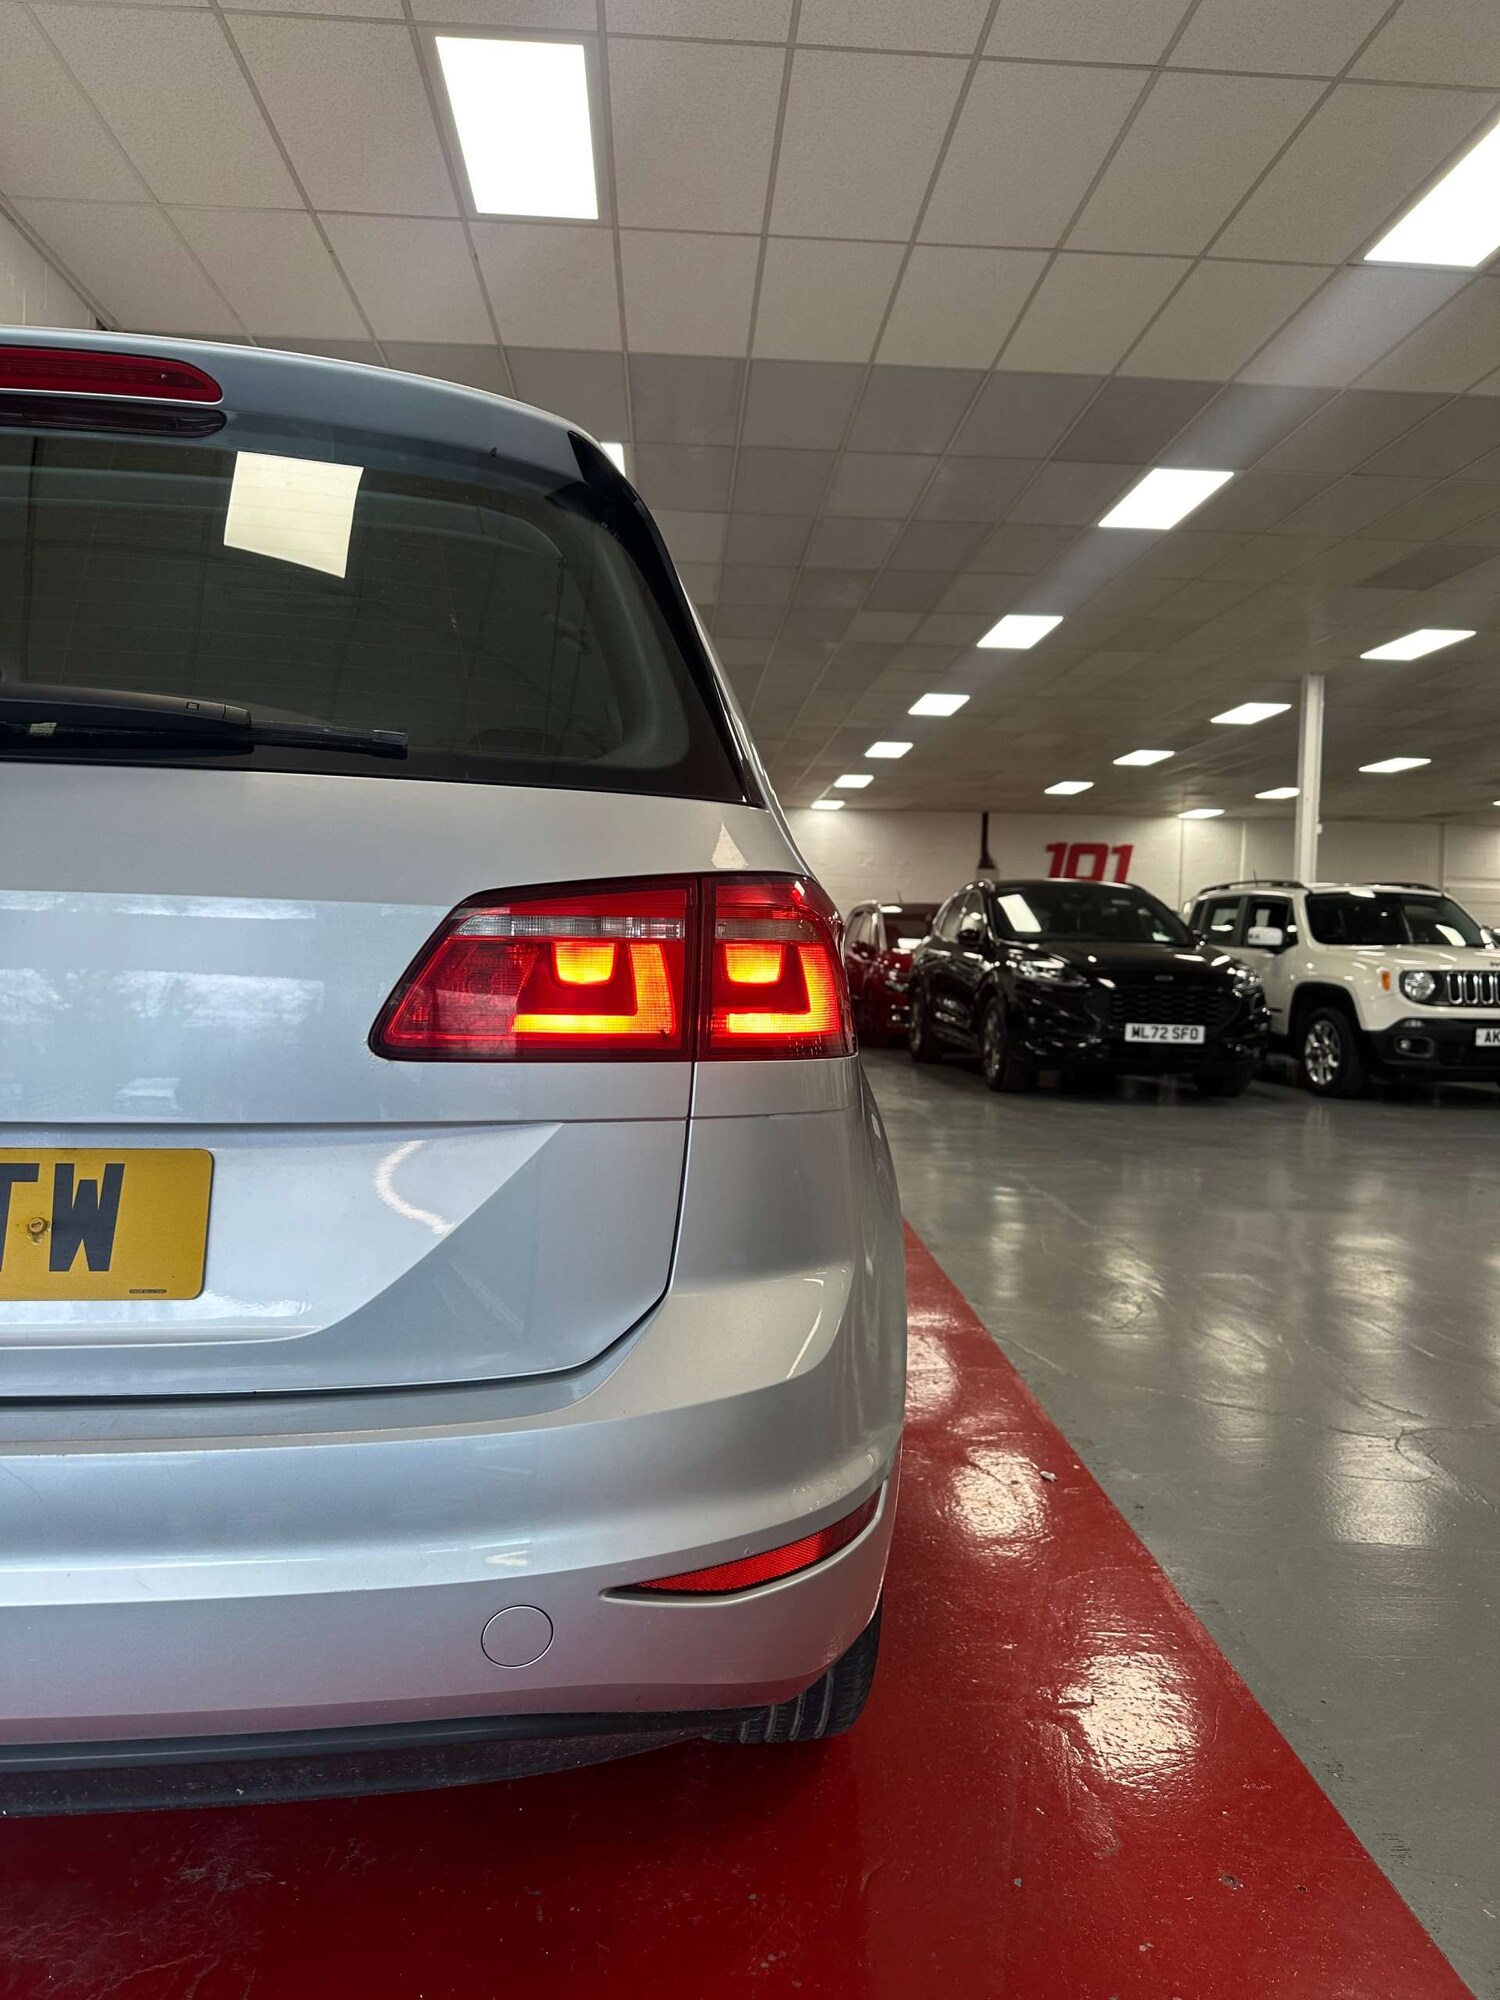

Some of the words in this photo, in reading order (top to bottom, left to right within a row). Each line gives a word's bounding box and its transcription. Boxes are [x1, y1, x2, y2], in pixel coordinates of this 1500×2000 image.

[1046, 842, 1134, 884] 101
[1171, 1026, 1199, 1041] SFO
[1483, 1030, 1500, 1043] AK
